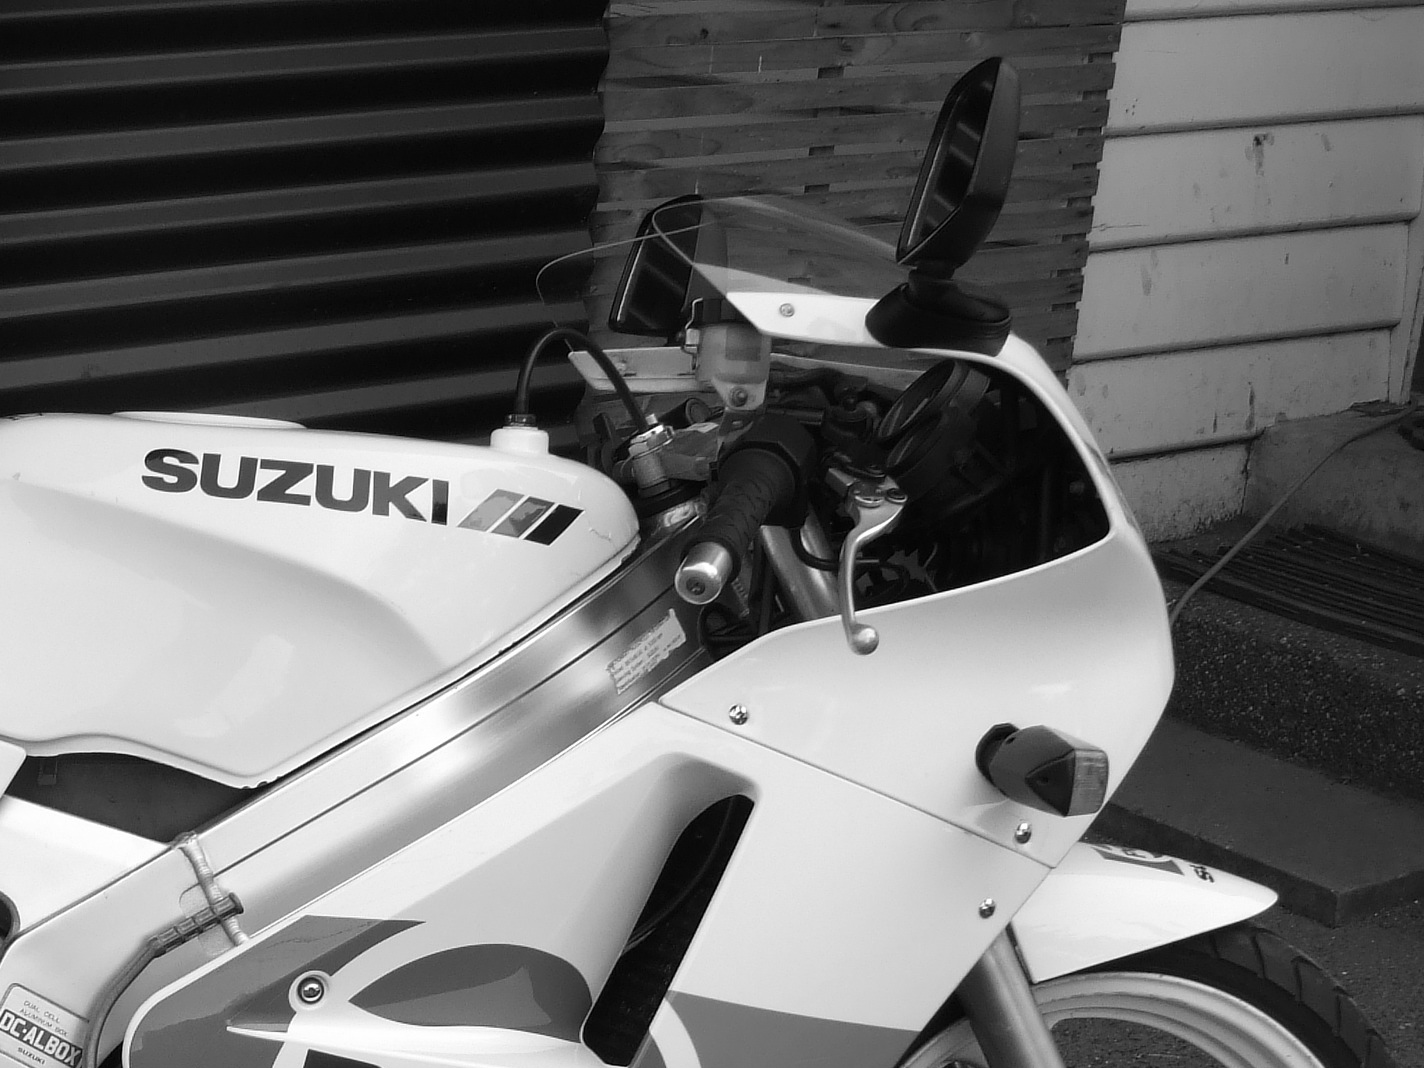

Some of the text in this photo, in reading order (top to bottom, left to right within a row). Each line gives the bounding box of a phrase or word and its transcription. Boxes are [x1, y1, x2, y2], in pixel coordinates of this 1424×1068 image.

[141, 448, 449, 526] SUZUKI
[23, 1000, 60, 1023] DUAL CELL
[17, 1046, 46, 1065] SUZUKI
